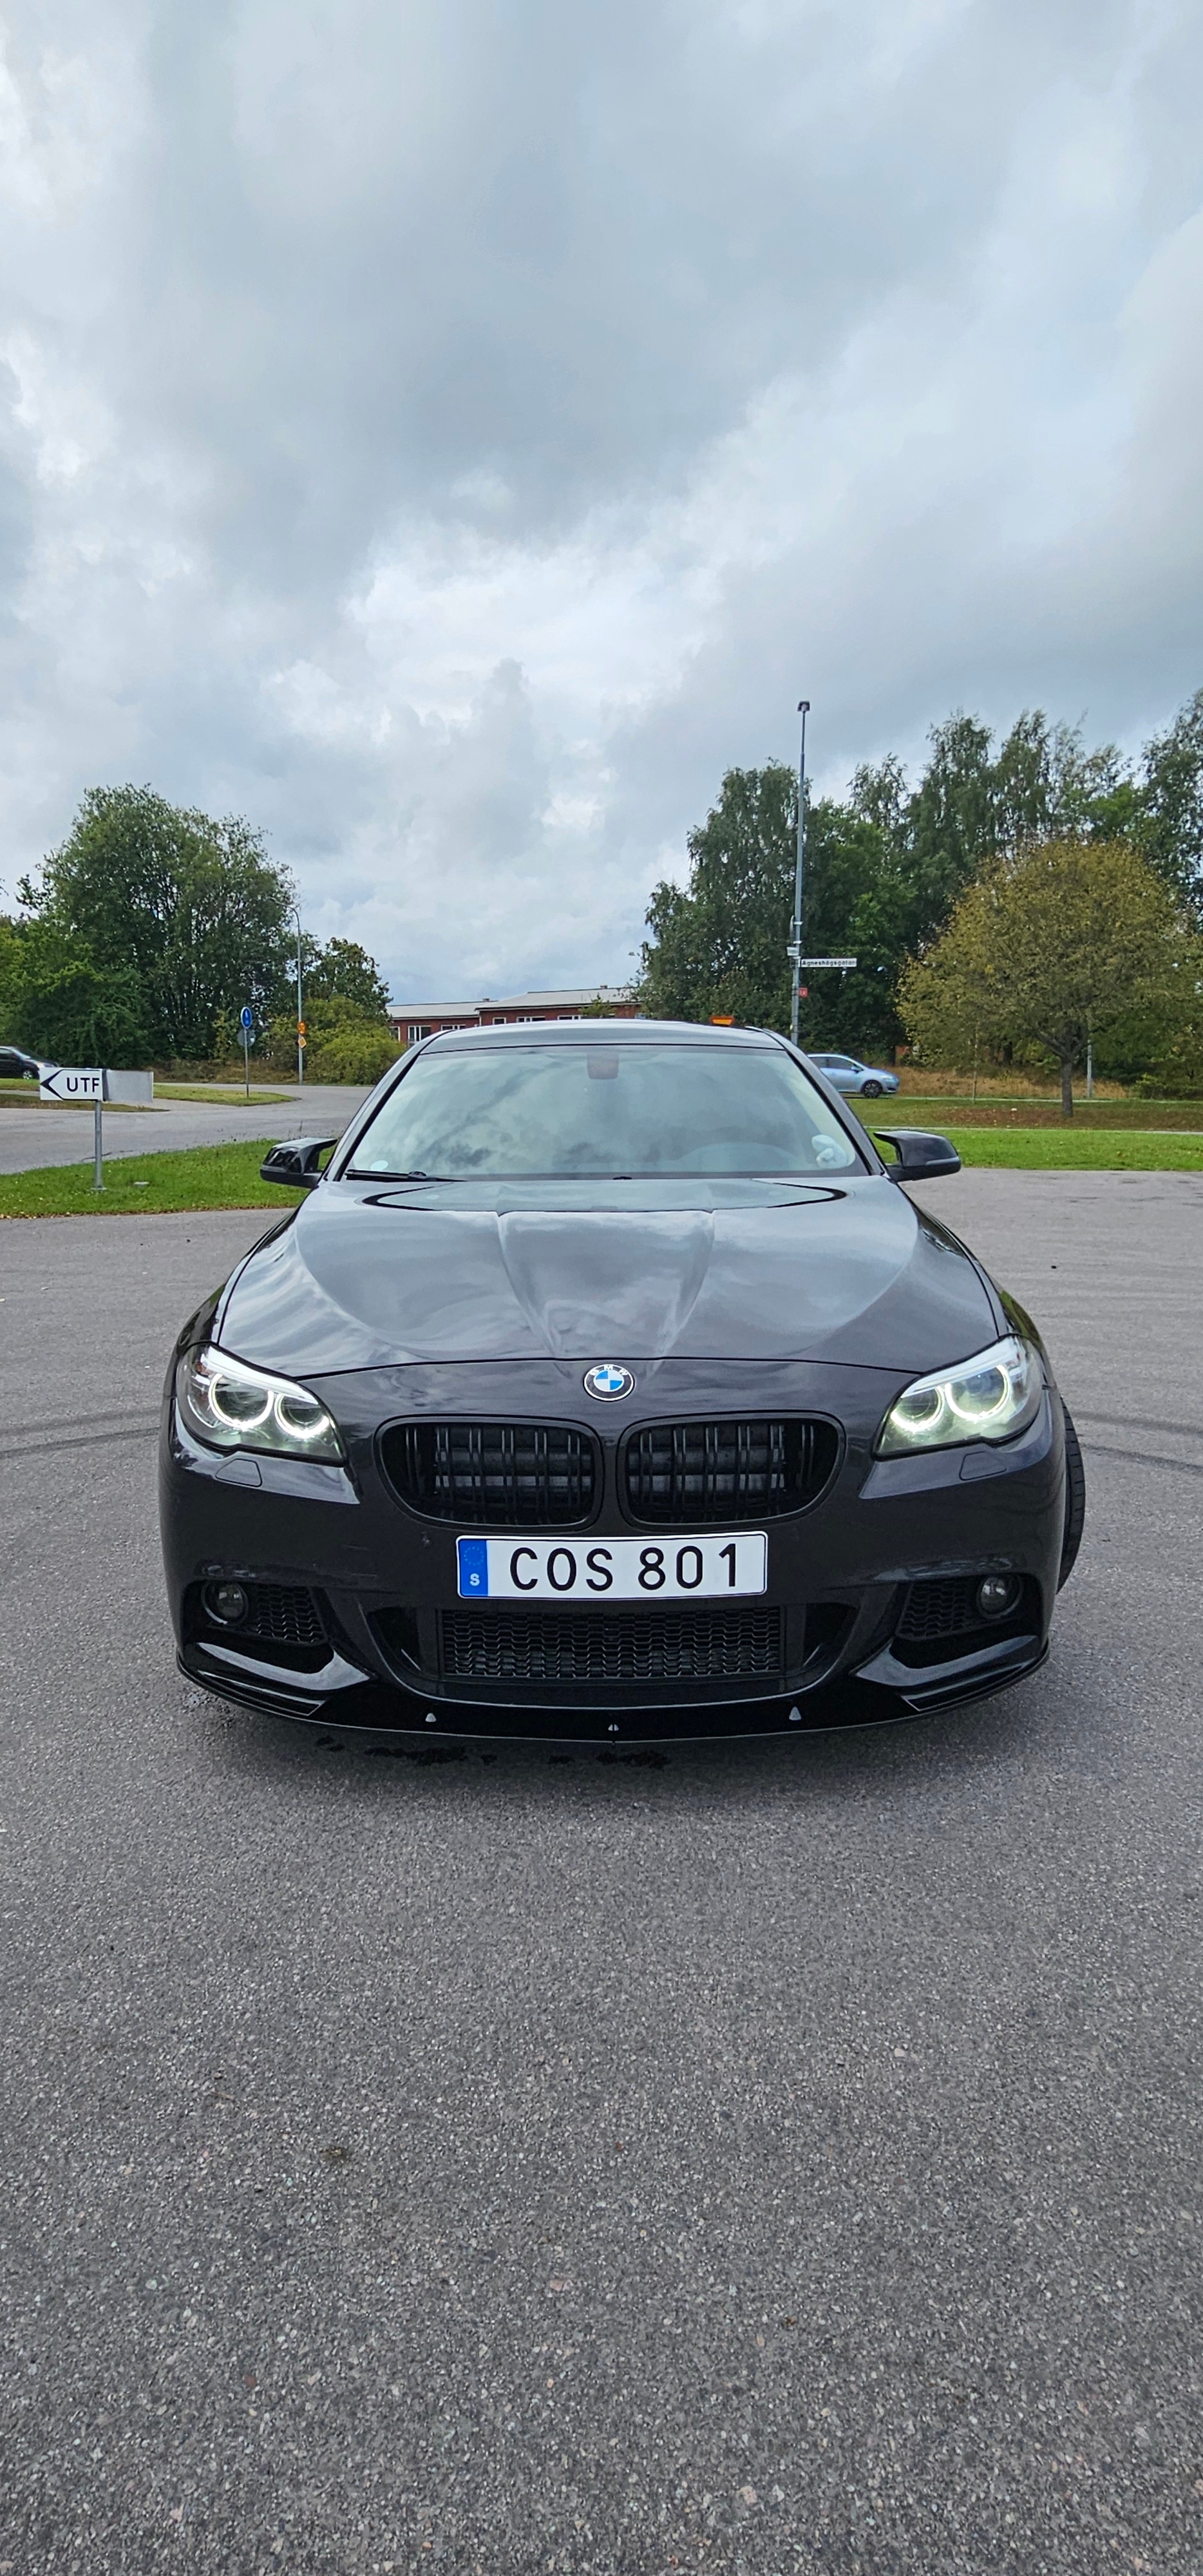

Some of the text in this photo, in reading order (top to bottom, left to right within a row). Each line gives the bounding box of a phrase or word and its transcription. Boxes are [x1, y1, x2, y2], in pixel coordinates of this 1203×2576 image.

[469, 1573, 480, 1586] S
[509, 1543, 737, 1591] COS 801
